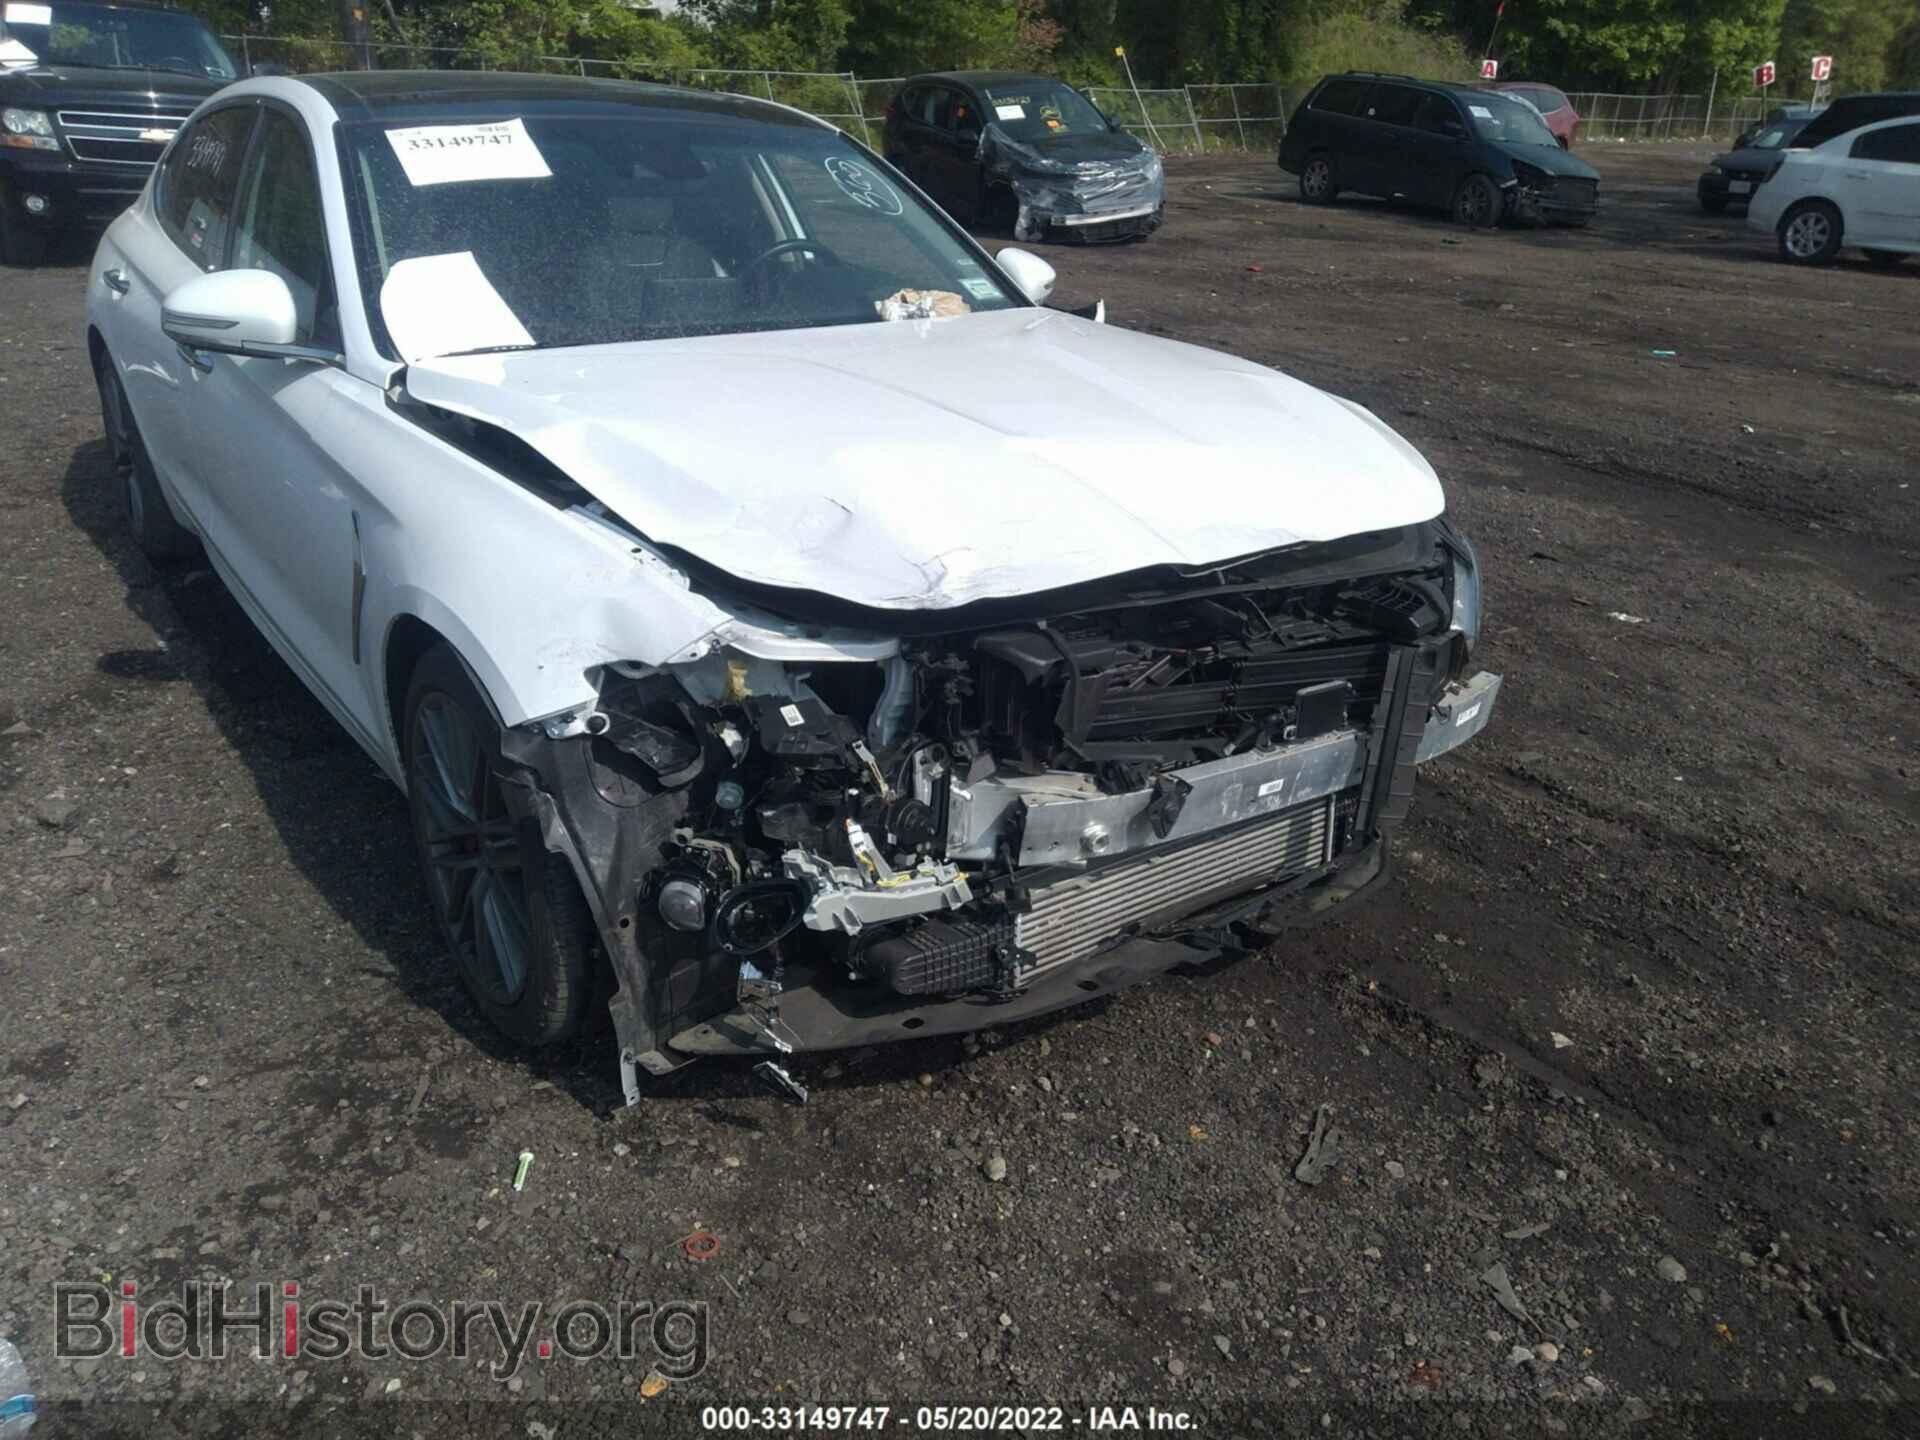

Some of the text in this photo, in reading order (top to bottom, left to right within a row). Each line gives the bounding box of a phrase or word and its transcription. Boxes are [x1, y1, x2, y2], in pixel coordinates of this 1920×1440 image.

[1482, 62, 1495, 77] A
[1756, 65, 1774, 85] B
[1814, 58, 1829, 80] C
[408, 134, 512, 151] 33149747
